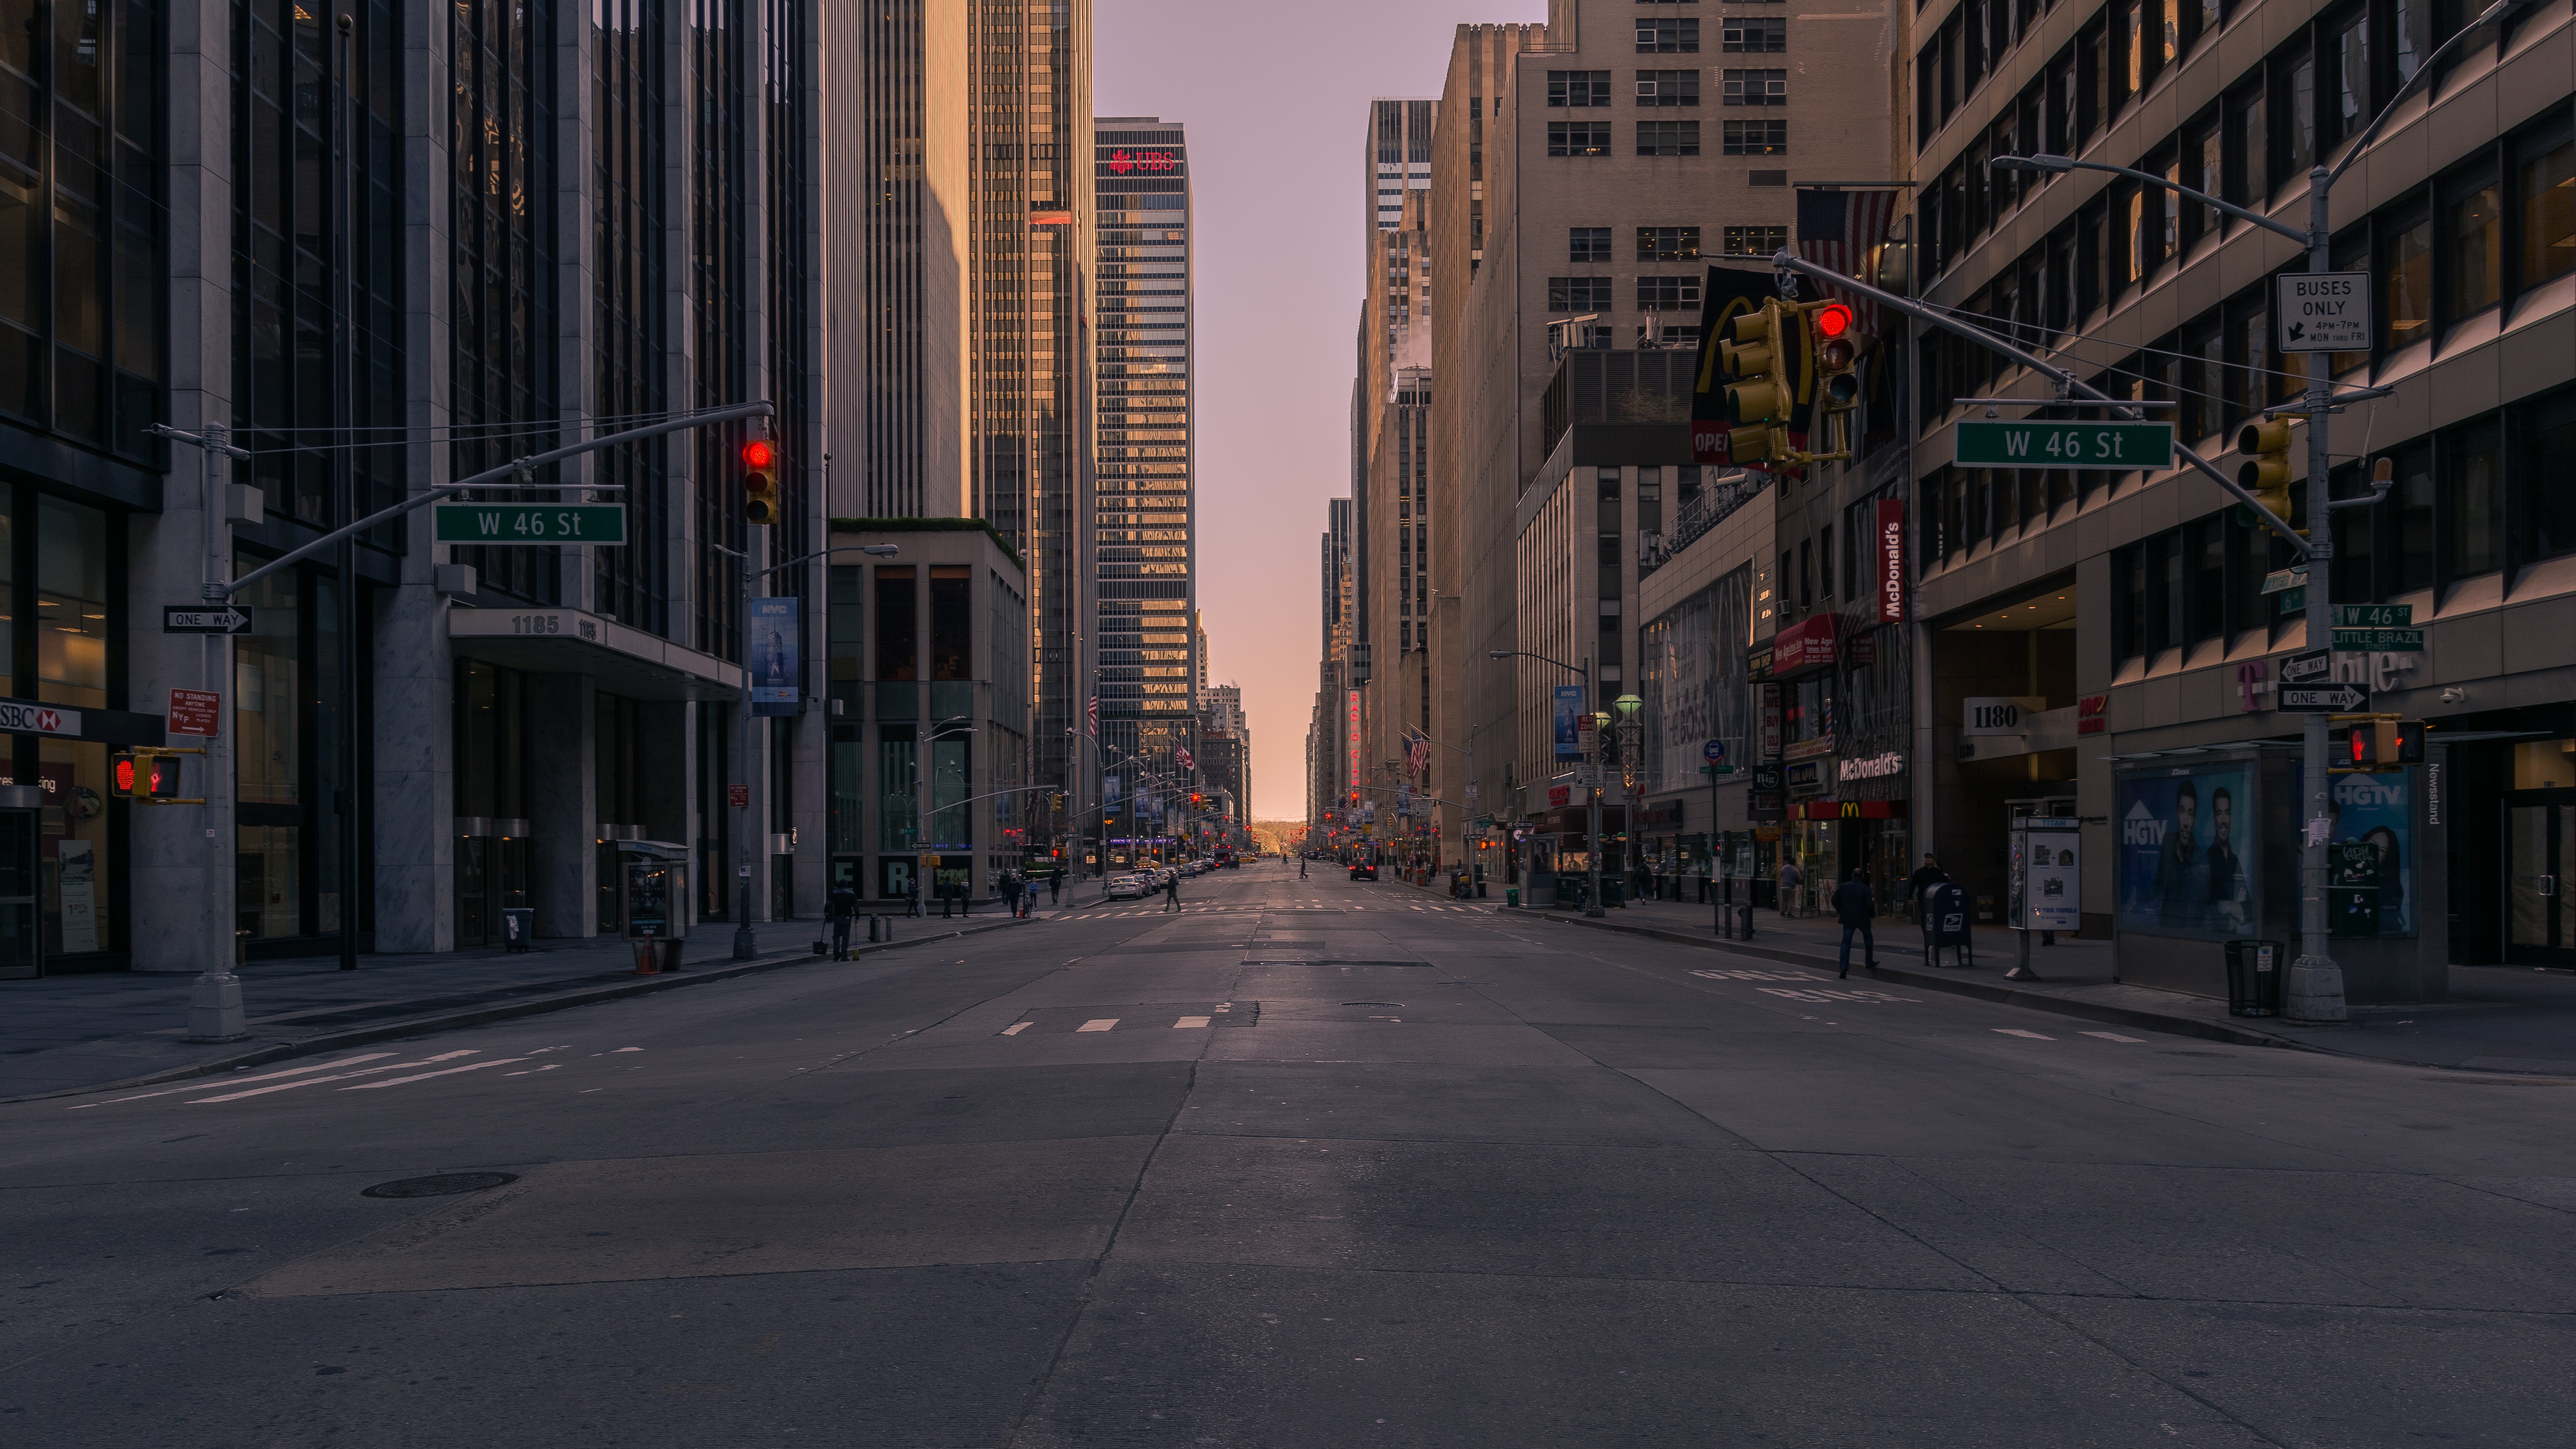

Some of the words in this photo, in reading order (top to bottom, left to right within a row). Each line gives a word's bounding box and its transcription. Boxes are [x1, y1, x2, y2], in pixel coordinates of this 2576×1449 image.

[1135, 152, 1174, 170] UBS
[2297, 281, 2351, 296] BUSES
[2303, 301, 2345, 316] ONLY
[2315, 321, 2359, 330] 4PM-7PM
[2310, 333, 2329, 342] MON
[2351, 332, 2365, 341] FRI
[1695, 433, 1728, 452] OPE
[2005, 431, 2030, 456] W
[2045, 431, 2080, 457] 46
[2095, 431, 2123, 458] St
[478, 513, 501, 535] W
[514, 512, 544, 535] 46
[558, 512, 581, 535] St
[1886, 522, 1900, 617] McDonald's
[762, 605, 787, 614] NYC
[2285, 594, 2291, 609] 6
[176, 614, 201, 625] ONE
[213, 614, 239, 625] WAY
[2347, 608, 2360, 624] W
[2369, 608, 2392, 624] 46
[2397, 608, 2408, 617] ST
[512, 616, 559, 634] 1185
[580, 618, 596, 641] 1185
[1821, 638, 1833, 646] Age
[2333, 632, 2372, 643] LITTLE
[2378, 632, 2422, 643] BRAZIL
[2287, 664, 2301, 677] ONE
[2307, 658, 2324, 671] WAY
[186, 693, 217, 702] STANDING
[1766, 696, 1780, 708] WE
[2291, 692, 2317, 704] ONE
[2330, 692, 2357, 704] WAY
[2079, 695, 2108, 717] HNA
[0, 705, 34, 729] SBC
[172, 711, 189, 723] NYP
[1351, 694, 1359, 741] RADIO
[1766, 716, 1779, 727] BUY
[1974, 705, 2017, 728] 1180
[1766, 734, 1779, 747] GOLD
[1959, 743, 1975, 759] 1180
[1351, 750, 1359, 786] CITY
[1840, 751, 1900, 781] McDonald's
[1756, 773, 1776, 784] Big
[2334, 785, 2402, 805] HGTV
[2429, 764, 2440, 824] Newsstand
[2123, 820, 2168, 845] HGTV
[887, 862, 909, 894] R
[937, 869, 962, 880] FOX
